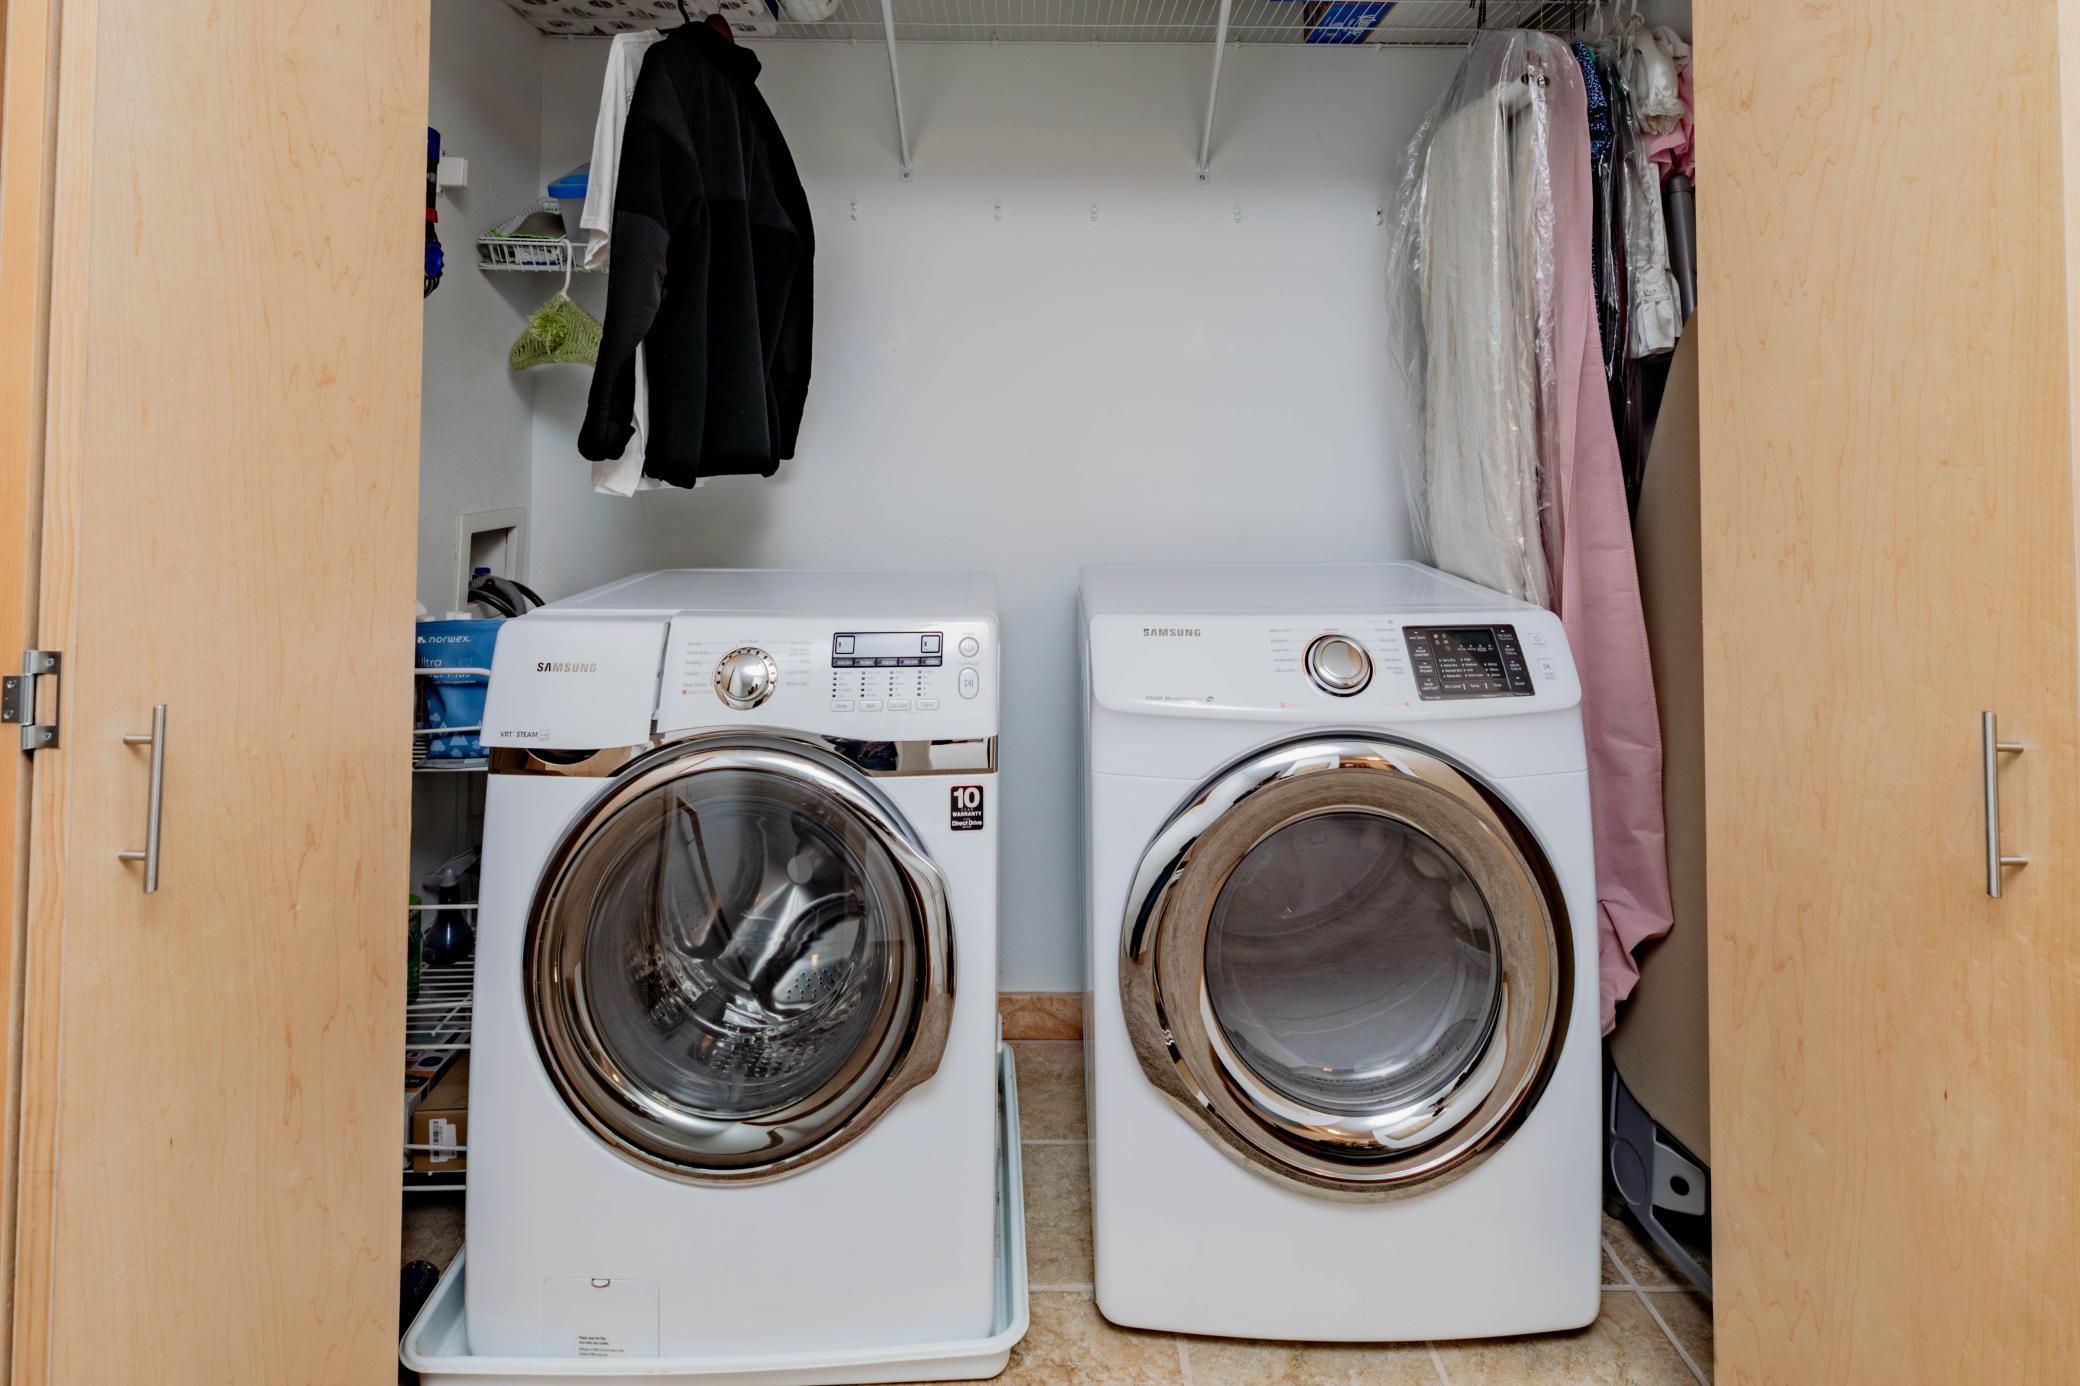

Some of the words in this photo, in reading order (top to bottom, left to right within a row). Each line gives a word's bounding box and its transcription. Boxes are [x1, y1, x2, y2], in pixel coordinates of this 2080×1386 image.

[1143, 628, 1201, 637] SAMSUNG
[418, 656, 442, 668] ltra
[536, 662, 598, 673] SAMSUNG
[953, 787, 981, 809] 10
